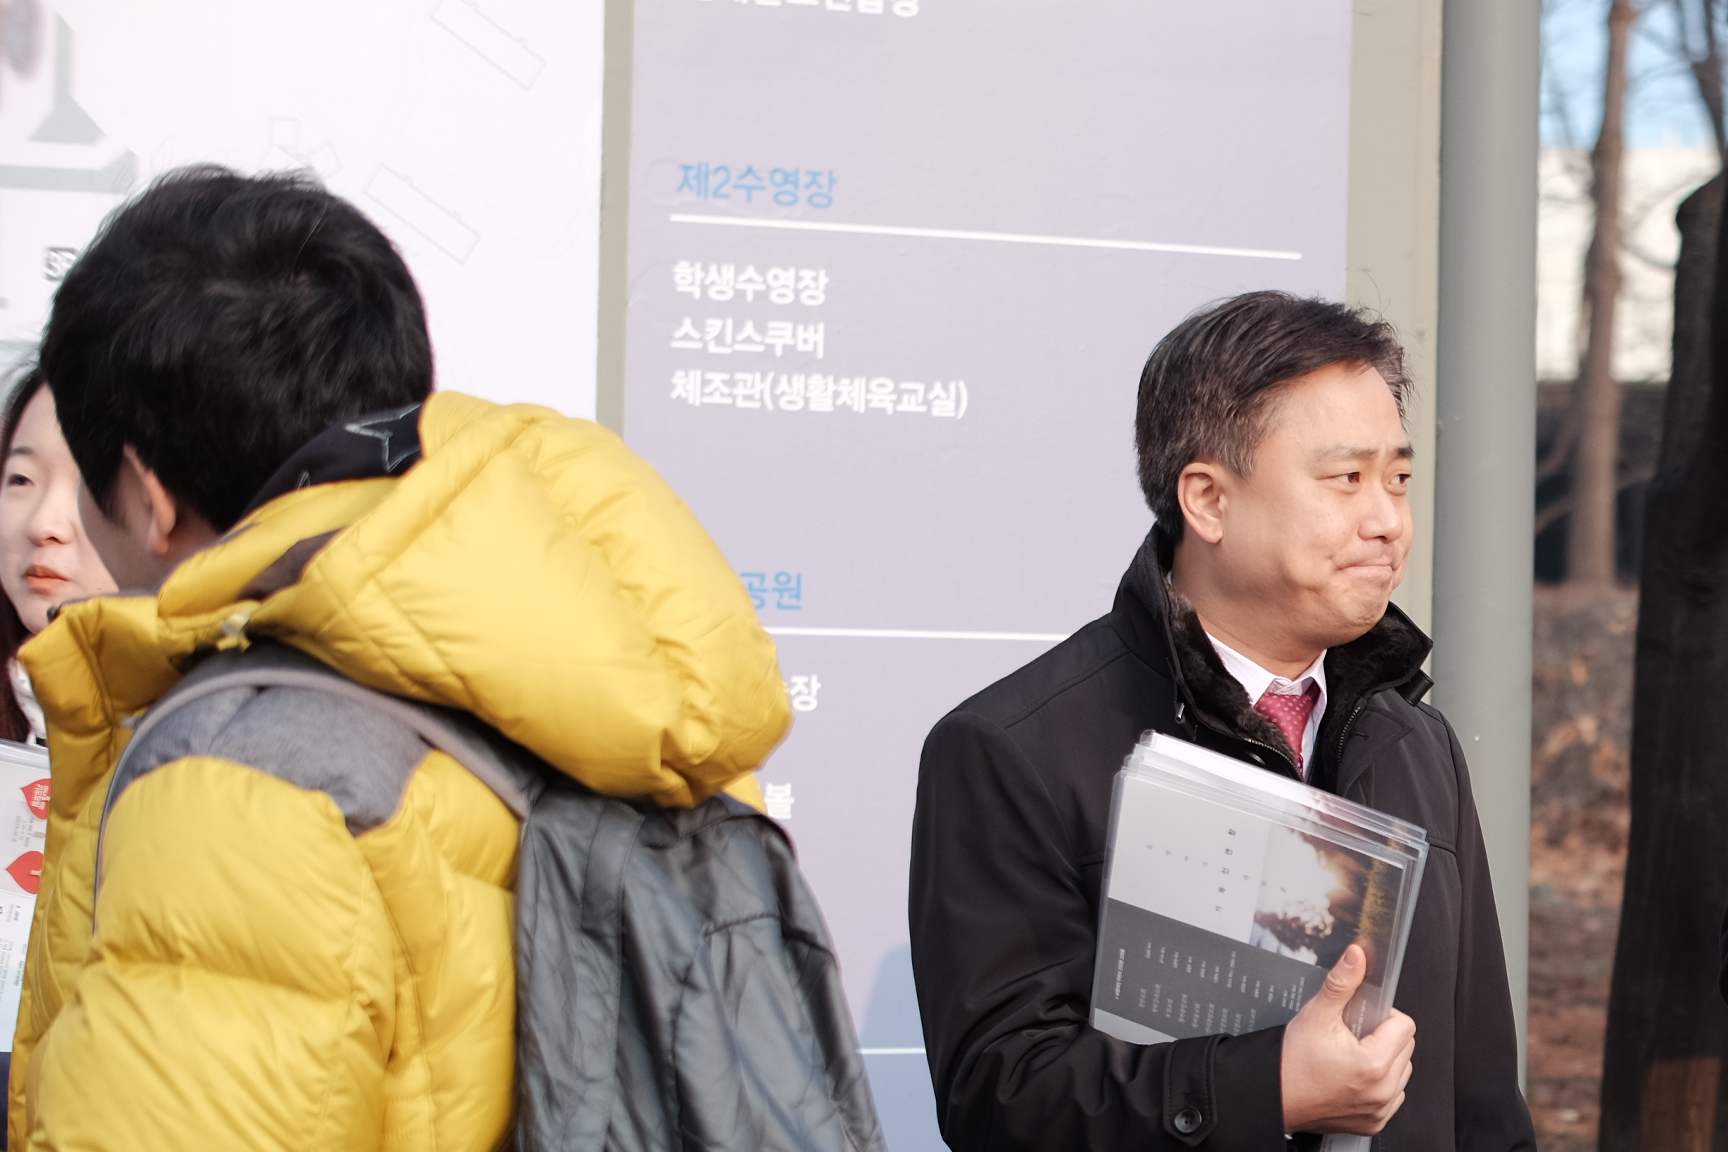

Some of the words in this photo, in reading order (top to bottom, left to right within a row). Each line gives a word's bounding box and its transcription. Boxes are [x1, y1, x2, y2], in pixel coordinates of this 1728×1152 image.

[677, 162, 838, 209] 제2수영장
[672, 261, 829, 306] 학생수영장
[670, 317, 825, 359] 스킨스쿠버
[670, 369, 968, 420] 체조관(생활체육교실)
[785, 674, 821, 712] 장
